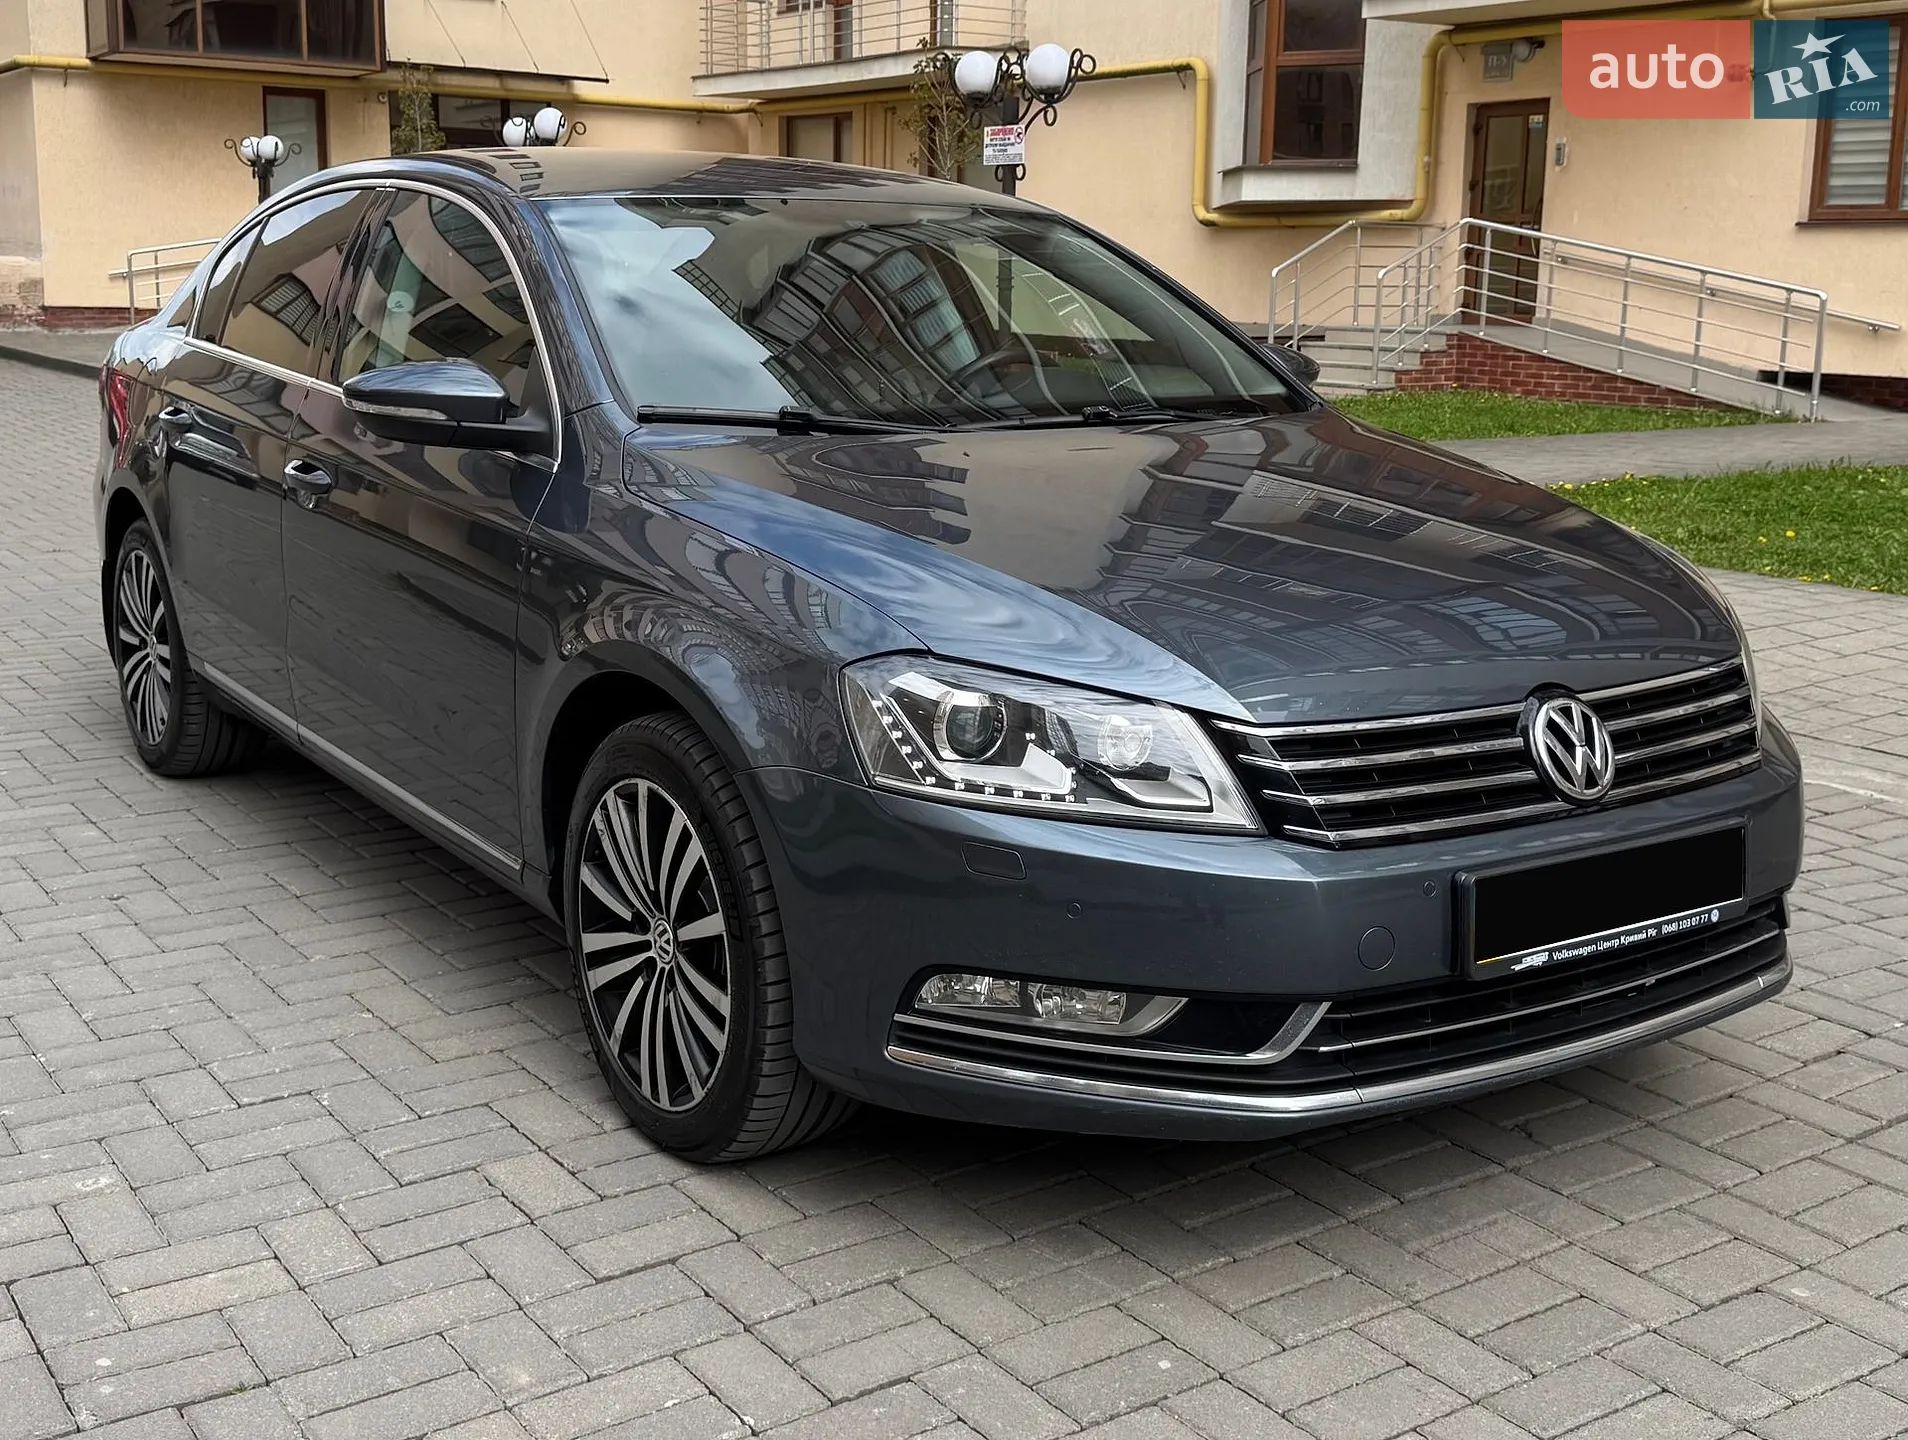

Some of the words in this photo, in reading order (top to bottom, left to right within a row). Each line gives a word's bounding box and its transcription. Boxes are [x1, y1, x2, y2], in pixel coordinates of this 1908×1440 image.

[1552, 944, 1597, 960] Volkswagen
[1597, 938, 1620, 951] Центр
[1661, 921, 1679, 935] (068)
[1679, 918, 1691, 930] 103
[1691, 916, 1700, 926] 07
[1700, 913, 1709, 924] 77
